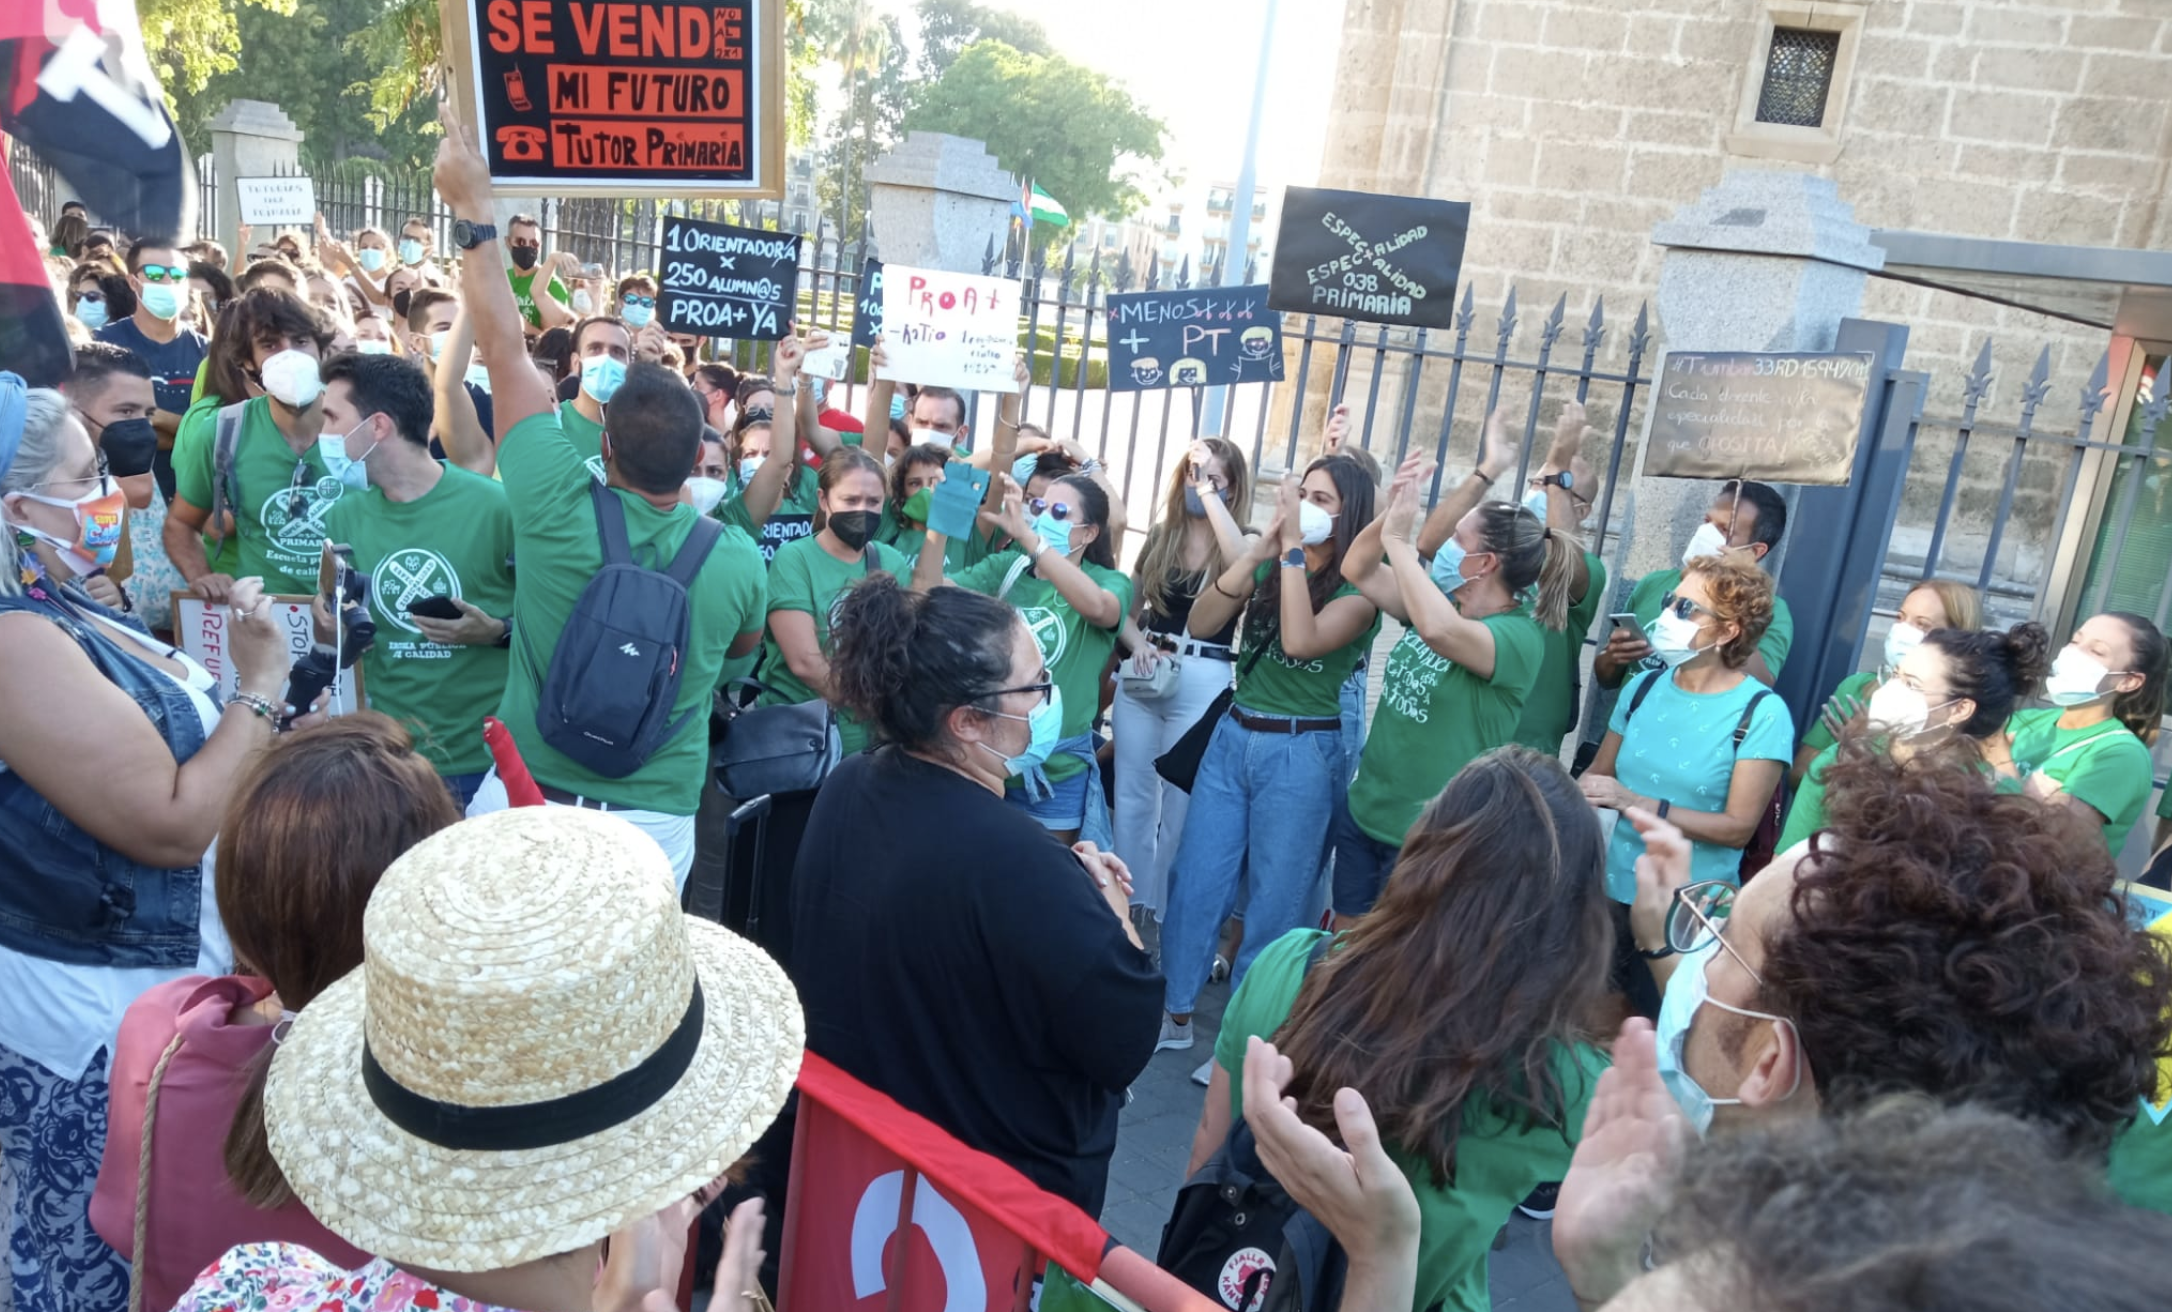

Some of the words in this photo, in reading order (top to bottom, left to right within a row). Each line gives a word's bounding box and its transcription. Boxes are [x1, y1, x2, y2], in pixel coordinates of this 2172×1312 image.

[487, 0, 555, 54] SE
[568, 2, 743, 60] VENDE
[555, 71, 589, 110] MI
[607, 72, 730, 113] FUTURO
[555, 123, 639, 166] TUTOR
[663, 261, 708, 287] 250
[707, 276, 782, 301] ALUMN@S
[1342, 272, 1379, 292] 038
[751, 303, 778, 336] YA
[1120, 297, 1200, 325] MENOS
[1182, 324, 1232, 356] PT
[266, 549, 307, 564] Escuela
[405, 651, 452, 659] CALIDAD
